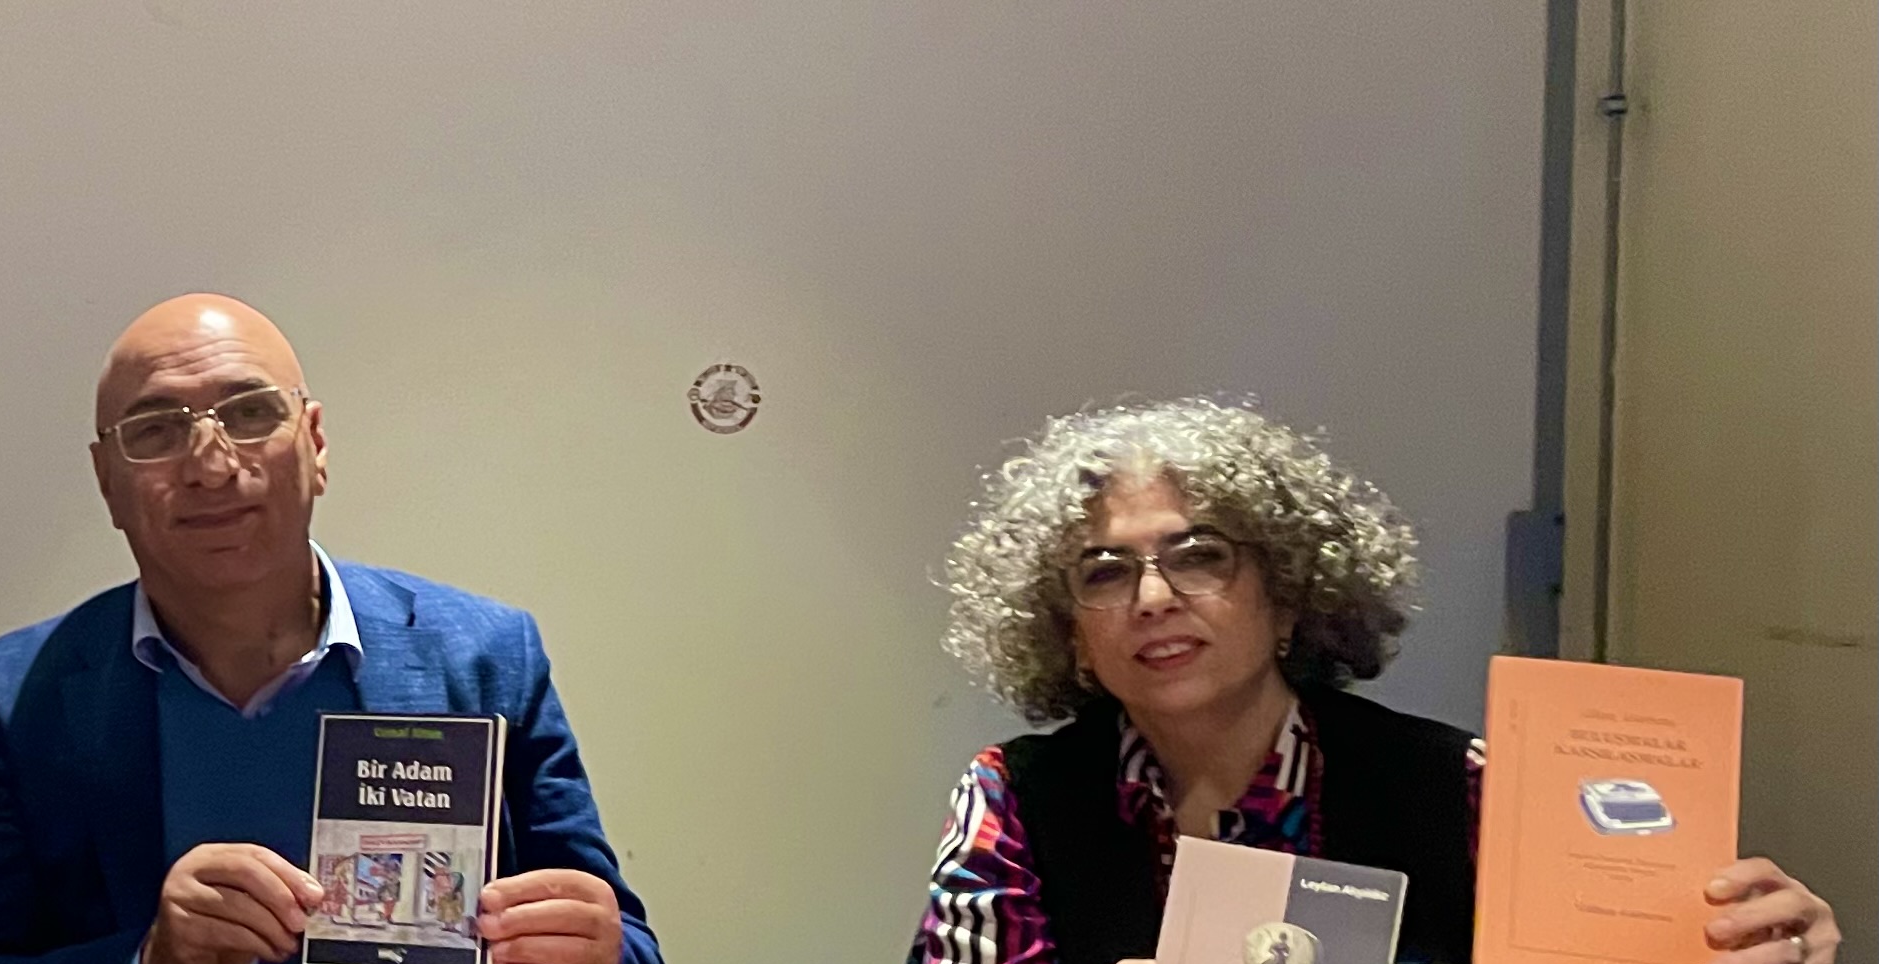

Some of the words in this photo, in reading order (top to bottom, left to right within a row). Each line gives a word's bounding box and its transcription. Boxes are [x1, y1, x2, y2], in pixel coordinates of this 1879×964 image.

[357, 759, 389, 779] Bir
[392, 760, 453, 781] Adam
[391, 787, 451, 809] Vatan
